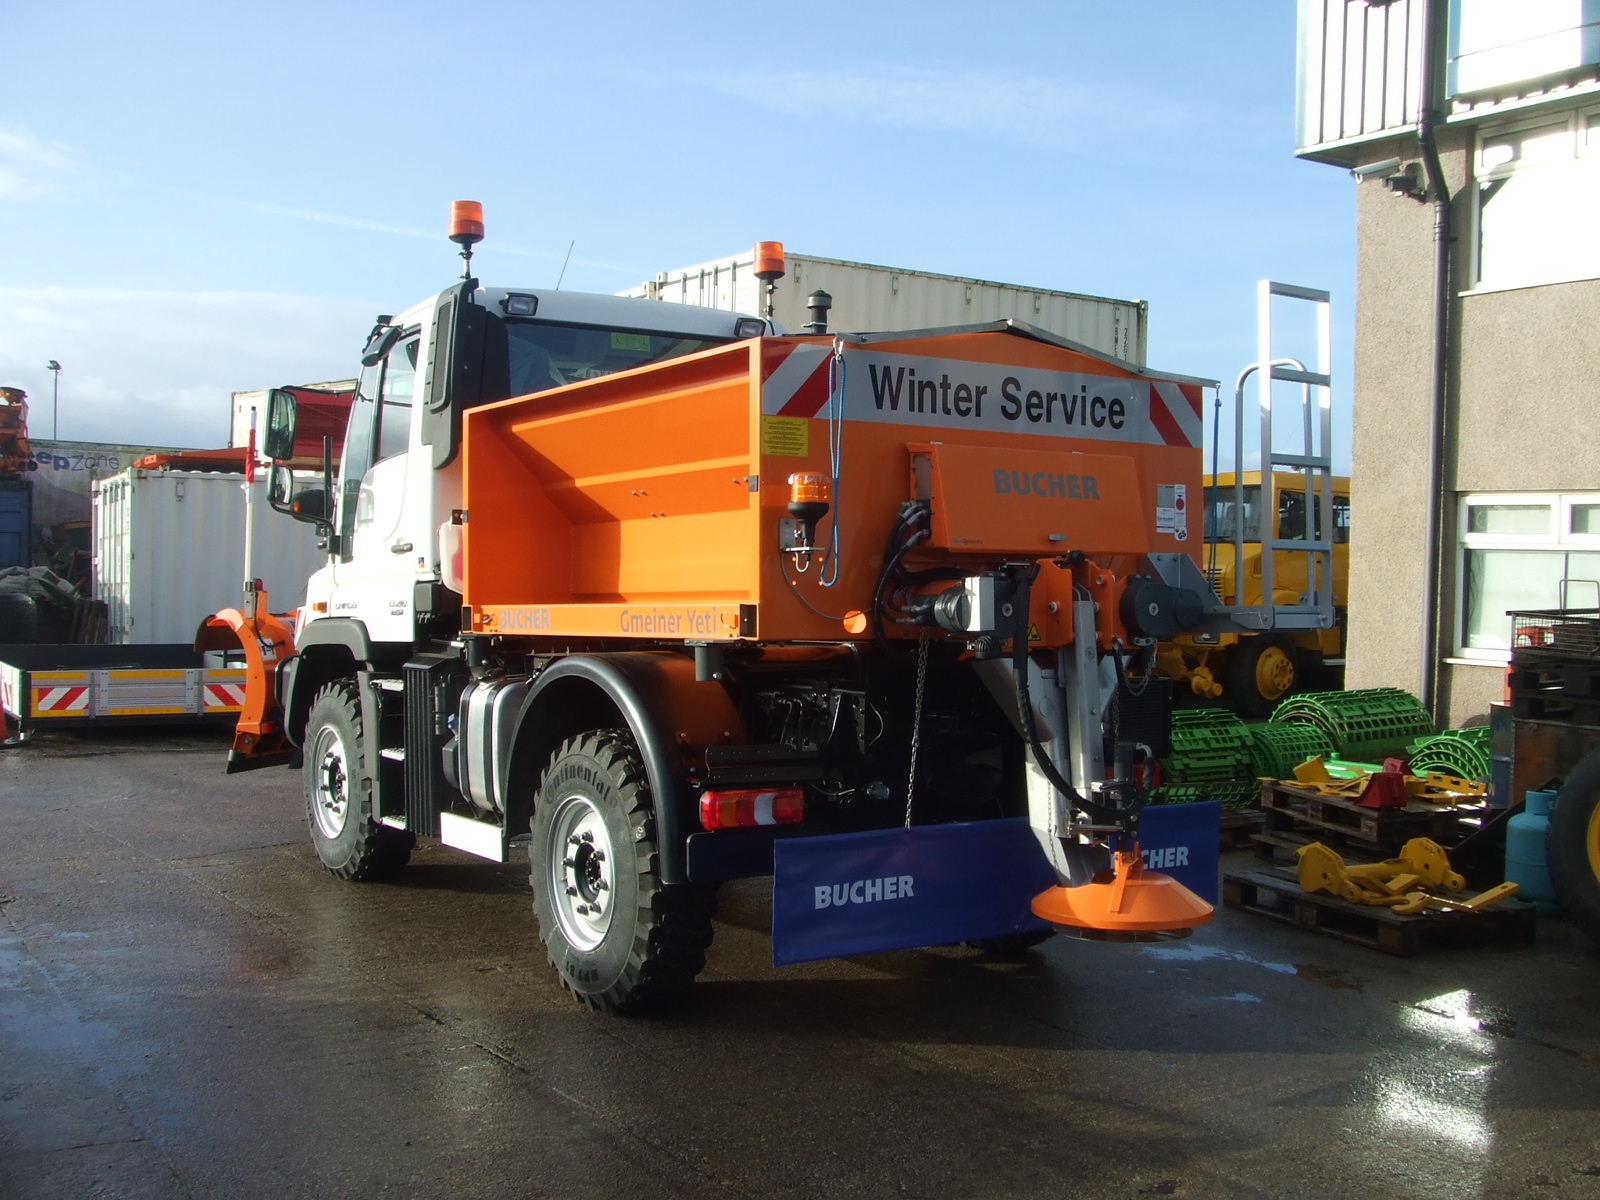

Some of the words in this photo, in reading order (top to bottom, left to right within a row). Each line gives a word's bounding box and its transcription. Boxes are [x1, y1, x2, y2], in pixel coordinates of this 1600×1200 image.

[868, 364, 987, 418] Winter
[1000, 376, 1125, 430] Service
[993, 469, 1101, 500] BUCHER
[500, 608, 550, 630] BUCHER
[620, 607, 682, 634] Gmeiner
[687, 606, 717, 635] Yeti
[814, 875, 915, 910] BUCHER
